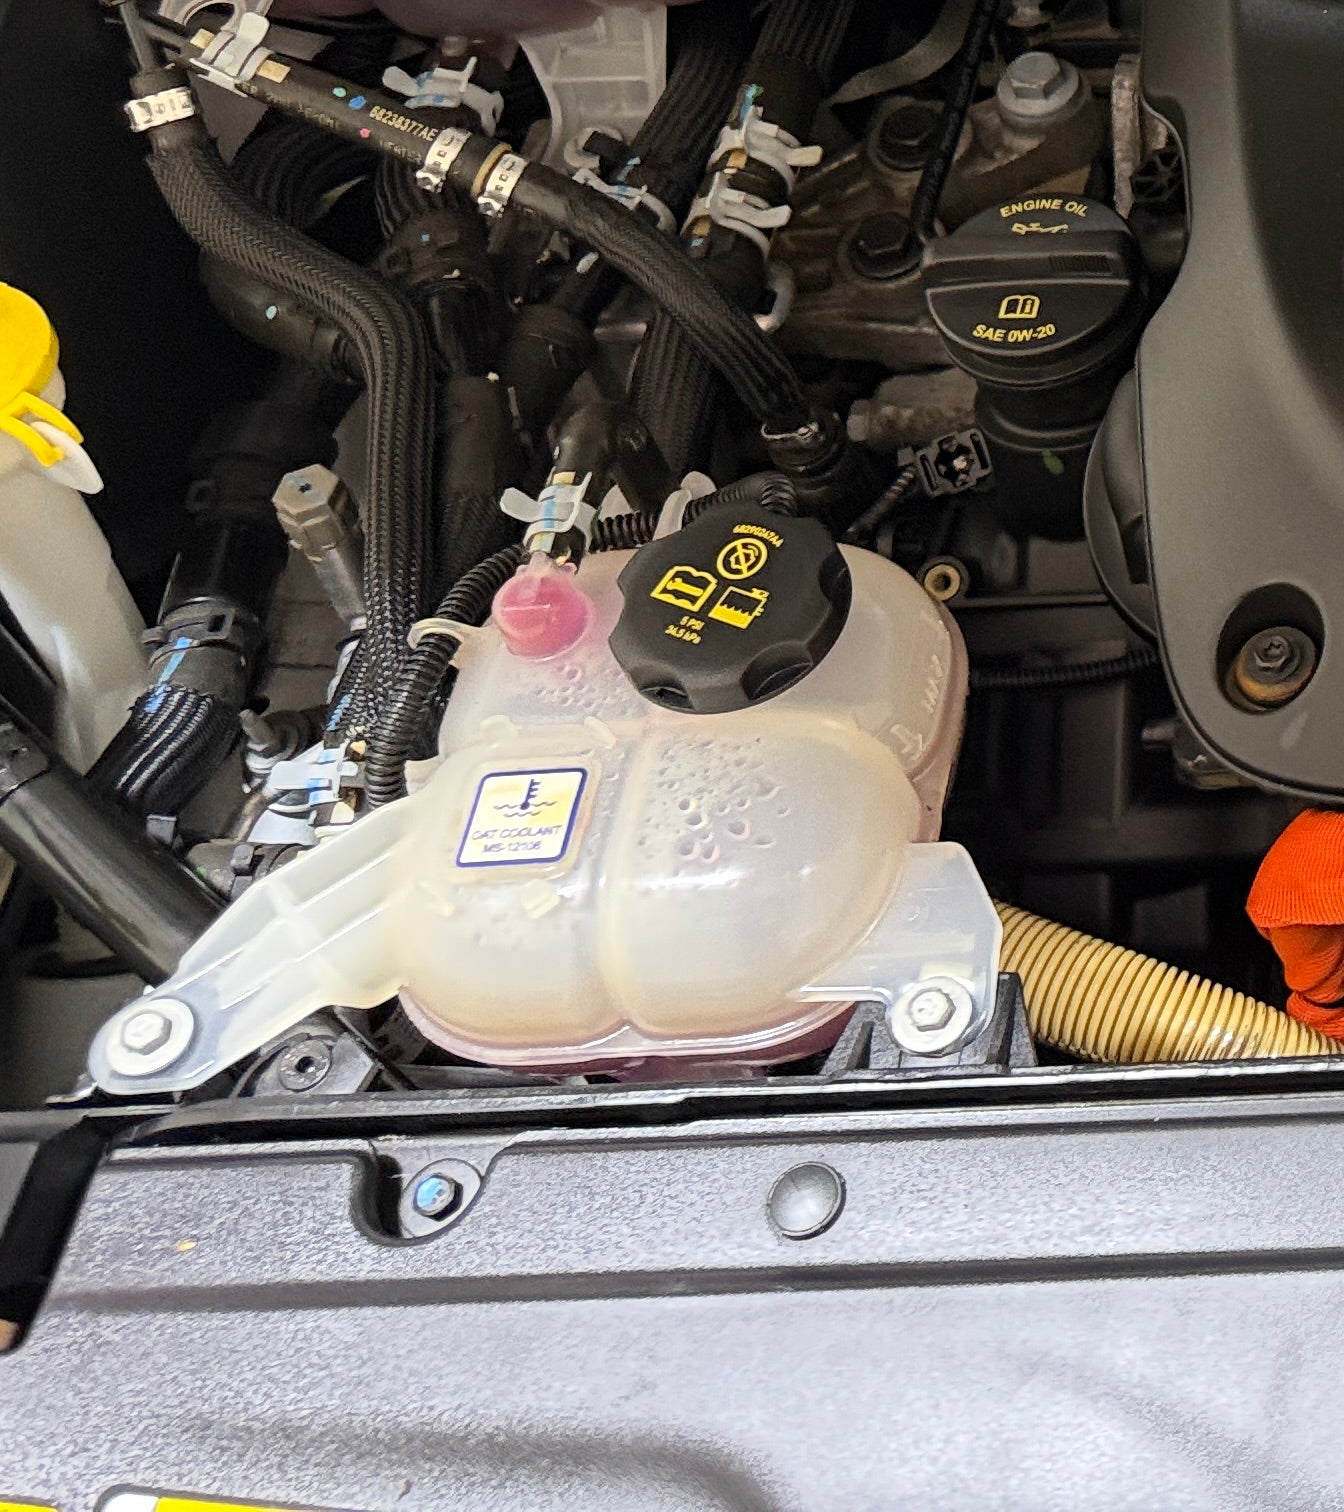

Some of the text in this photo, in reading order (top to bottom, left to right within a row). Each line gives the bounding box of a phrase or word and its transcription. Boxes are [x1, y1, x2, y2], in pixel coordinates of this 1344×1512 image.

[999, 198, 1089, 218] ENGINE OIL
[972, 323, 1056, 342] SAE 0W-20
[500, 824, 562, 838] COOLANT
